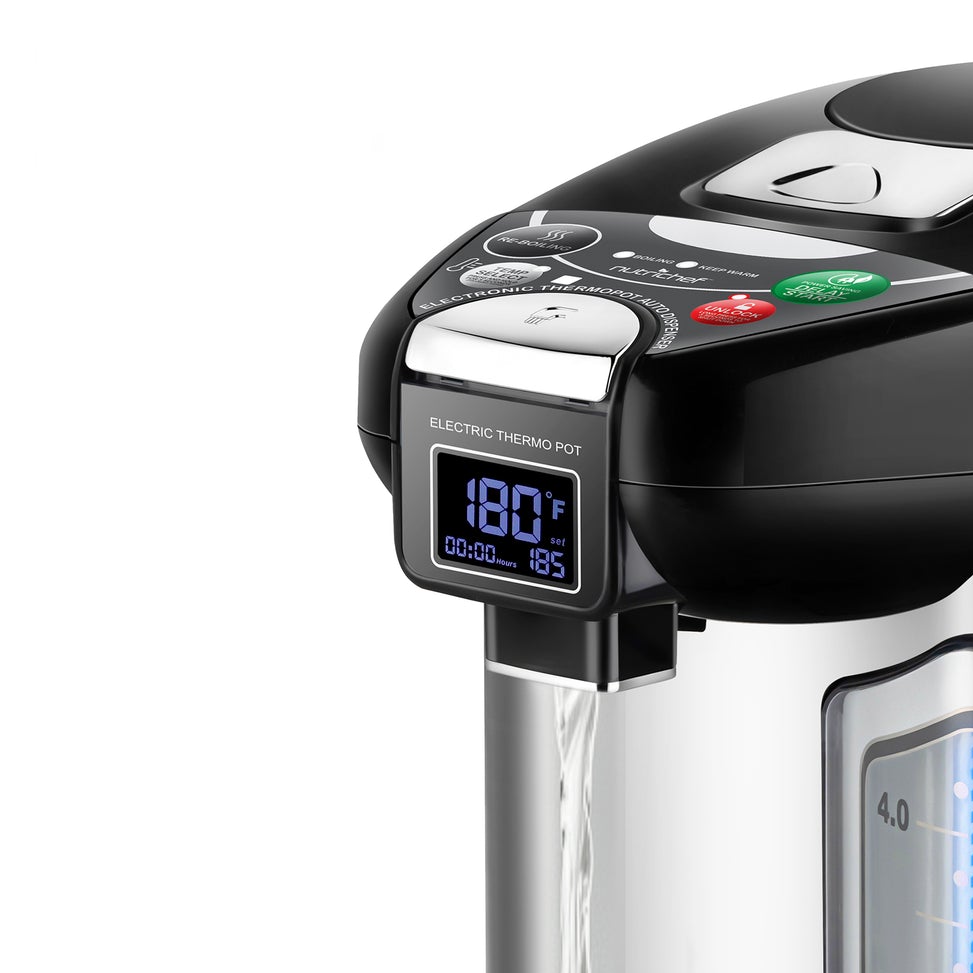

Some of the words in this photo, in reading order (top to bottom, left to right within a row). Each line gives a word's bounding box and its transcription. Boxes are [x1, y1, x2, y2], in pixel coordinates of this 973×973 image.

[497, 236, 572, 251] RE-BOILING
[632, 254, 675, 264] BOILING
[475, 269, 528, 281] SELECT
[494, 266, 529, 275] TEMP
[609, 265, 710, 284] nutrichef
[698, 265, 727, 273] KEEP
[726, 269, 759, 279] WARM
[419, 285, 534, 311] ELECTRONIC
[539, 284, 643, 300] THERMOPOT
[783, 290, 847, 302] START
[796, 284, 850, 297] DELAY
[636, 298, 670, 313] AUTO
[704, 305, 763, 318] UNLOCK
[651, 312, 679, 349] DISPENSER
[430, 417, 493, 439] ELECTRIC
[496, 429, 552, 450] THERMO
[555, 442, 582, 456] POT
[466, 477, 542, 544] 180
[445, 535, 496, 563] 00:00
[496, 558, 517, 568] Hours
[529, 547, 565, 579] 185
[877, 791, 910, 832] 4.0
